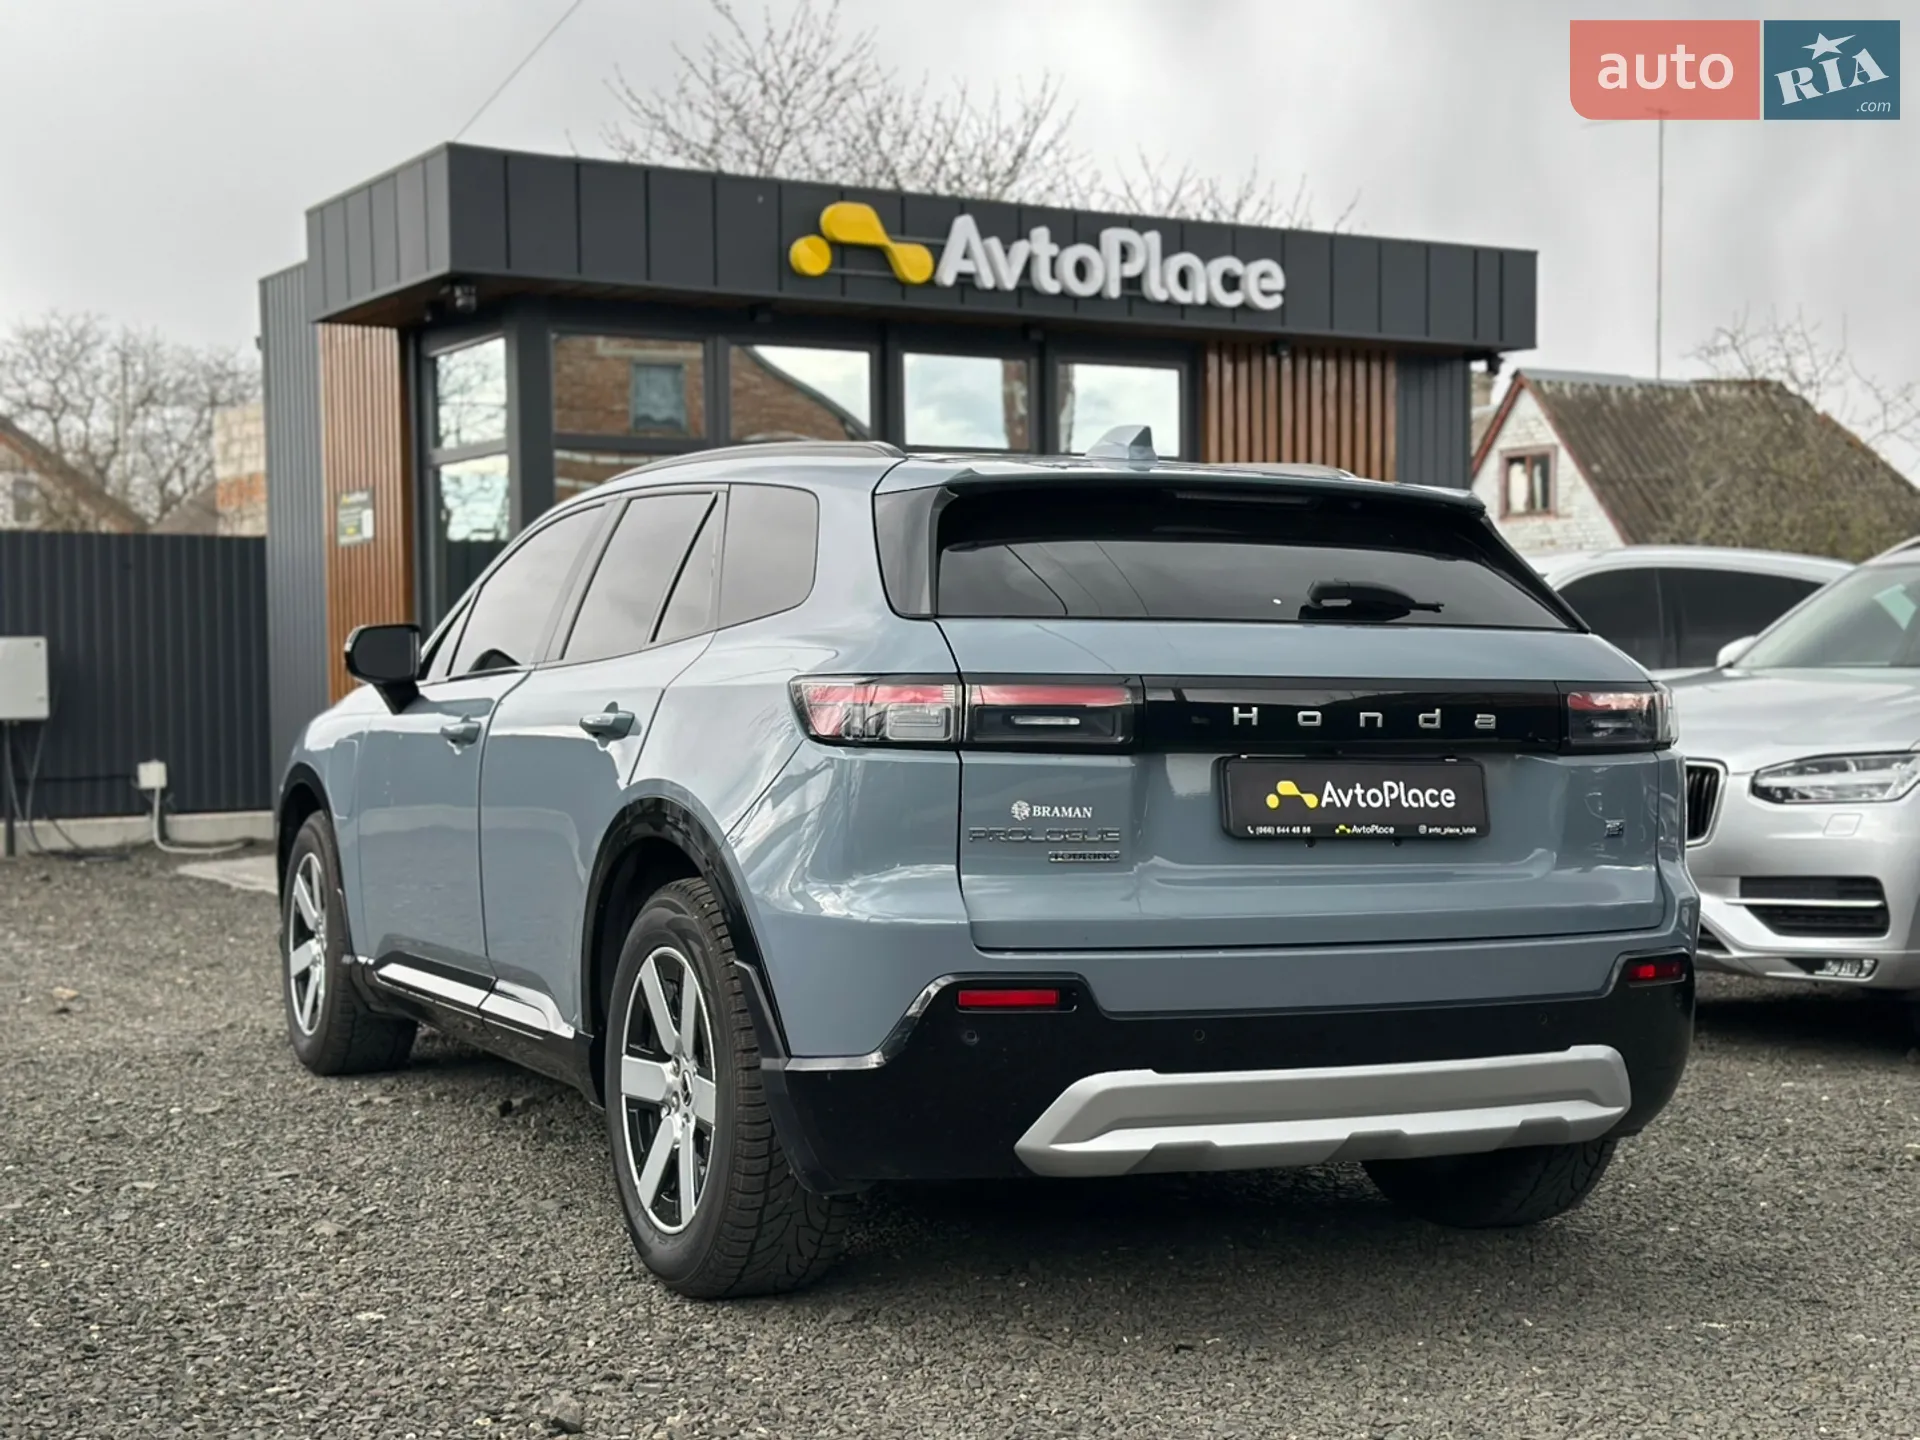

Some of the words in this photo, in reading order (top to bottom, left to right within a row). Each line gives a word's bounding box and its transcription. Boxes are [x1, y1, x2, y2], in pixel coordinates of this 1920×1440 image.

[936, 213, 1286, 311] AvtoPlace
[1232, 706, 1497, 730] Honda
[1320, 780, 1456, 809] AvtoPlace
[1032, 805, 1093, 819] BRAMAN
[968, 827, 1120, 843] PROLOGUE
[1351, 824, 1395, 834] AvtoPlace
